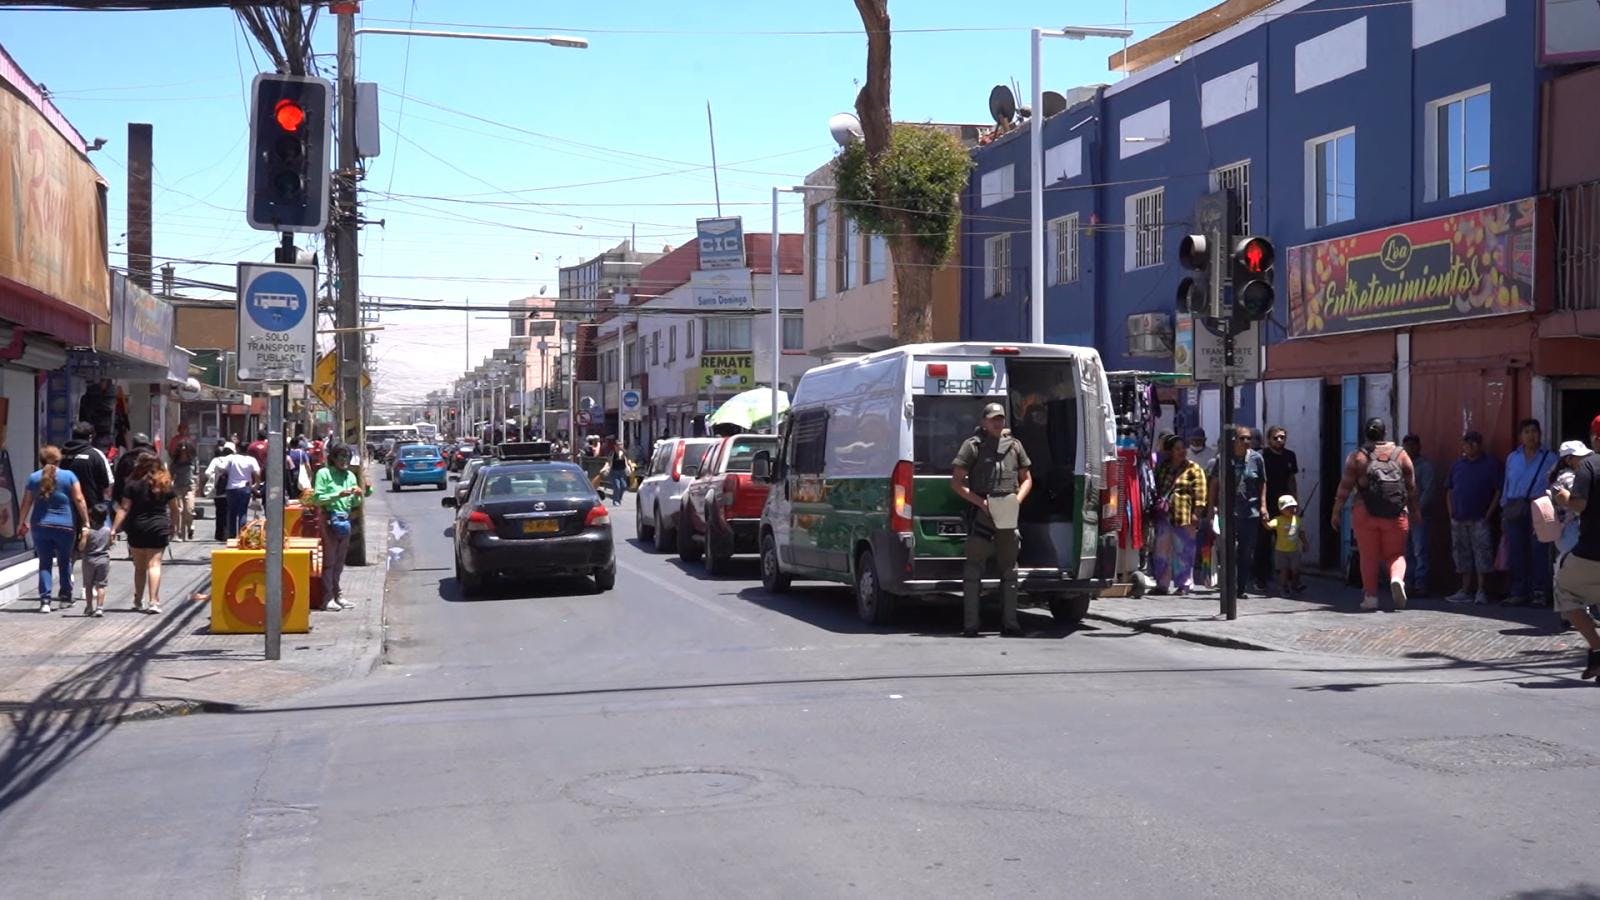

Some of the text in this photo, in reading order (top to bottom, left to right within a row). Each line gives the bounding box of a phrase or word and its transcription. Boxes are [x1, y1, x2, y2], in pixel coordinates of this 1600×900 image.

[701, 237, 739, 252] CIC
[1323, 255, 1483, 317] Entretenimientos
[718, 294, 748, 306] Domingo
[265, 333, 289, 342] SOLO
[247, 342, 307, 353] TRANSPORTE
[701, 356, 752, 368] REMATE
[937, 379, 985, 394] RETEN
